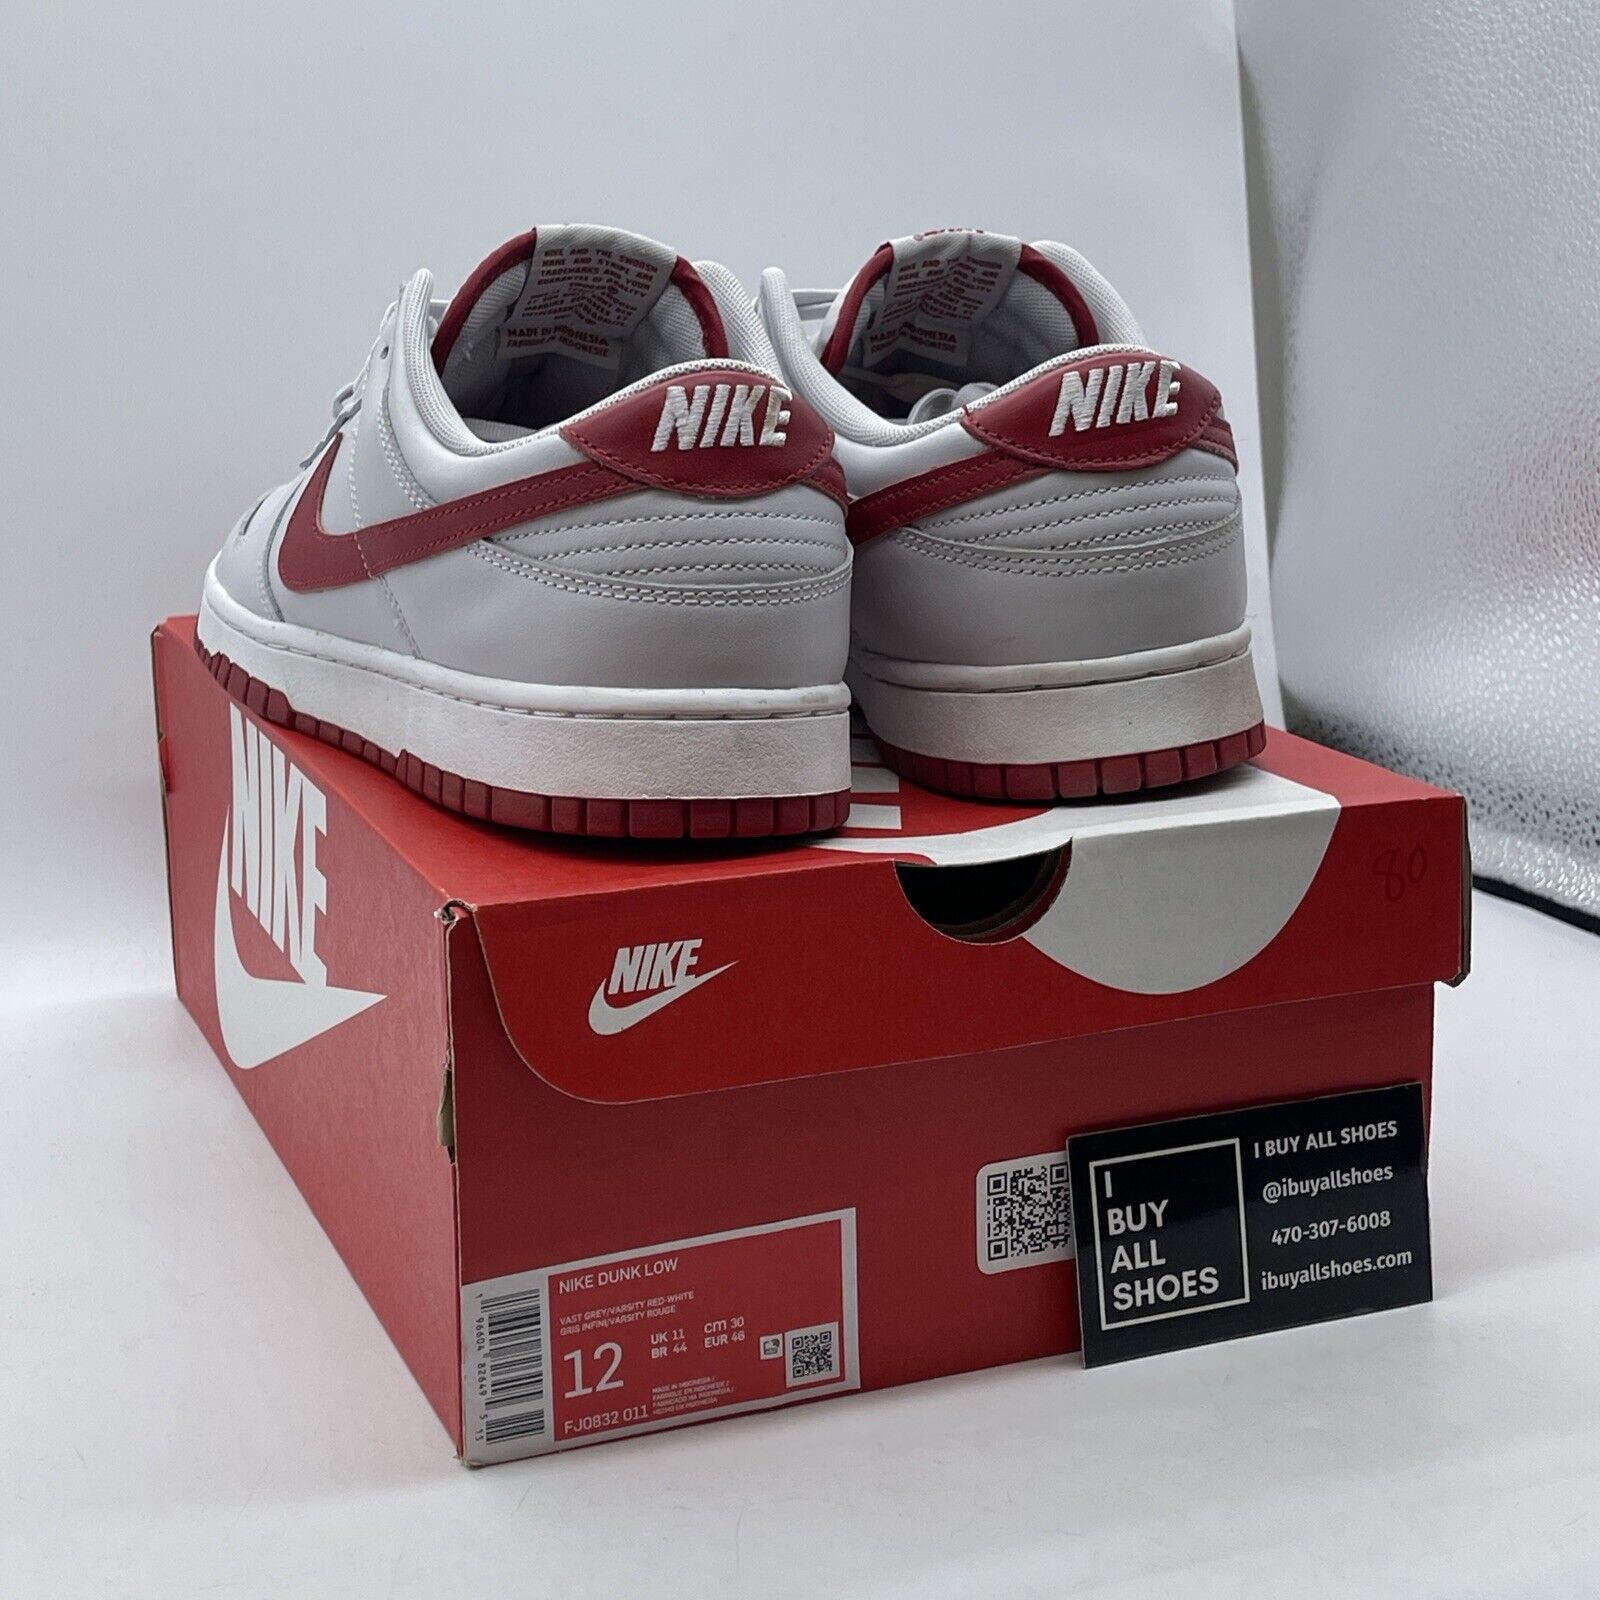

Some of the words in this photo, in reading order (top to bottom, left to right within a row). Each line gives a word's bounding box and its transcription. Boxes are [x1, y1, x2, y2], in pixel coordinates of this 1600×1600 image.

[570, 248, 589, 256] AND
[595, 249, 613, 258] THE
[573, 257, 592, 265] AND
[603, 268, 622, 280] AND
[626, 278, 651, 291] YOUR
[507, 327, 538, 338] MADE
[1048, 359, 1182, 437] NIKE
[650, 384, 793, 452] NIKE
[228, 701, 327, 987] NIKE
[1371, 846, 1428, 902] 80
[607, 938, 703, 995] NIKE
[1254, 1142, 1260, 1159] I
[1265, 1135, 1300, 1157] BUY
[1305, 1130, 1337, 1150] ALL
[1340, 1120, 1398, 1145] SHOES
[1104, 1170, 1113, 1198] I
[1262, 1165, 1394, 1204] @ibuyallshoes
[1107, 1198, 1169, 1236] BUY
[1271, 1210, 1391, 1246] 470-307-6008
[1110, 1239, 1166, 1274] ALL
[1261, 1250, 1413, 1291] ibuyallshoes.com
[559, 1273, 594, 1294] NIKE
[598, 1264, 641, 1287] DUNK
[644, 1257, 678, 1277] LOW
[1113, 1266, 1220, 1311] SHOES
[560, 1312, 582, 1326] VAST
[583, 1299, 646, 1321] GREY/VARSITY
[646, 1289, 695, 1308] RED-WHITE
[560, 1323, 581, 1337] GRIS
[646, 1304, 676, 1319] ROUGE
[704, 1320, 727, 1335] cm
[730, 1316, 745, 1329] 30
[650, 1331, 669, 1345] UK
[672, 1328, 686, 1341] 11
[651, 1346, 668, 1359] BR
[672, 1342, 688, 1354] 44
[704, 1334, 729, 1349] EUR
[731, 1330, 745, 1342] 46
[563, 1342, 624, 1399] 12
[564, 1410, 620, 1434] FJ0832
[622, 1404, 649, 1422] 011
